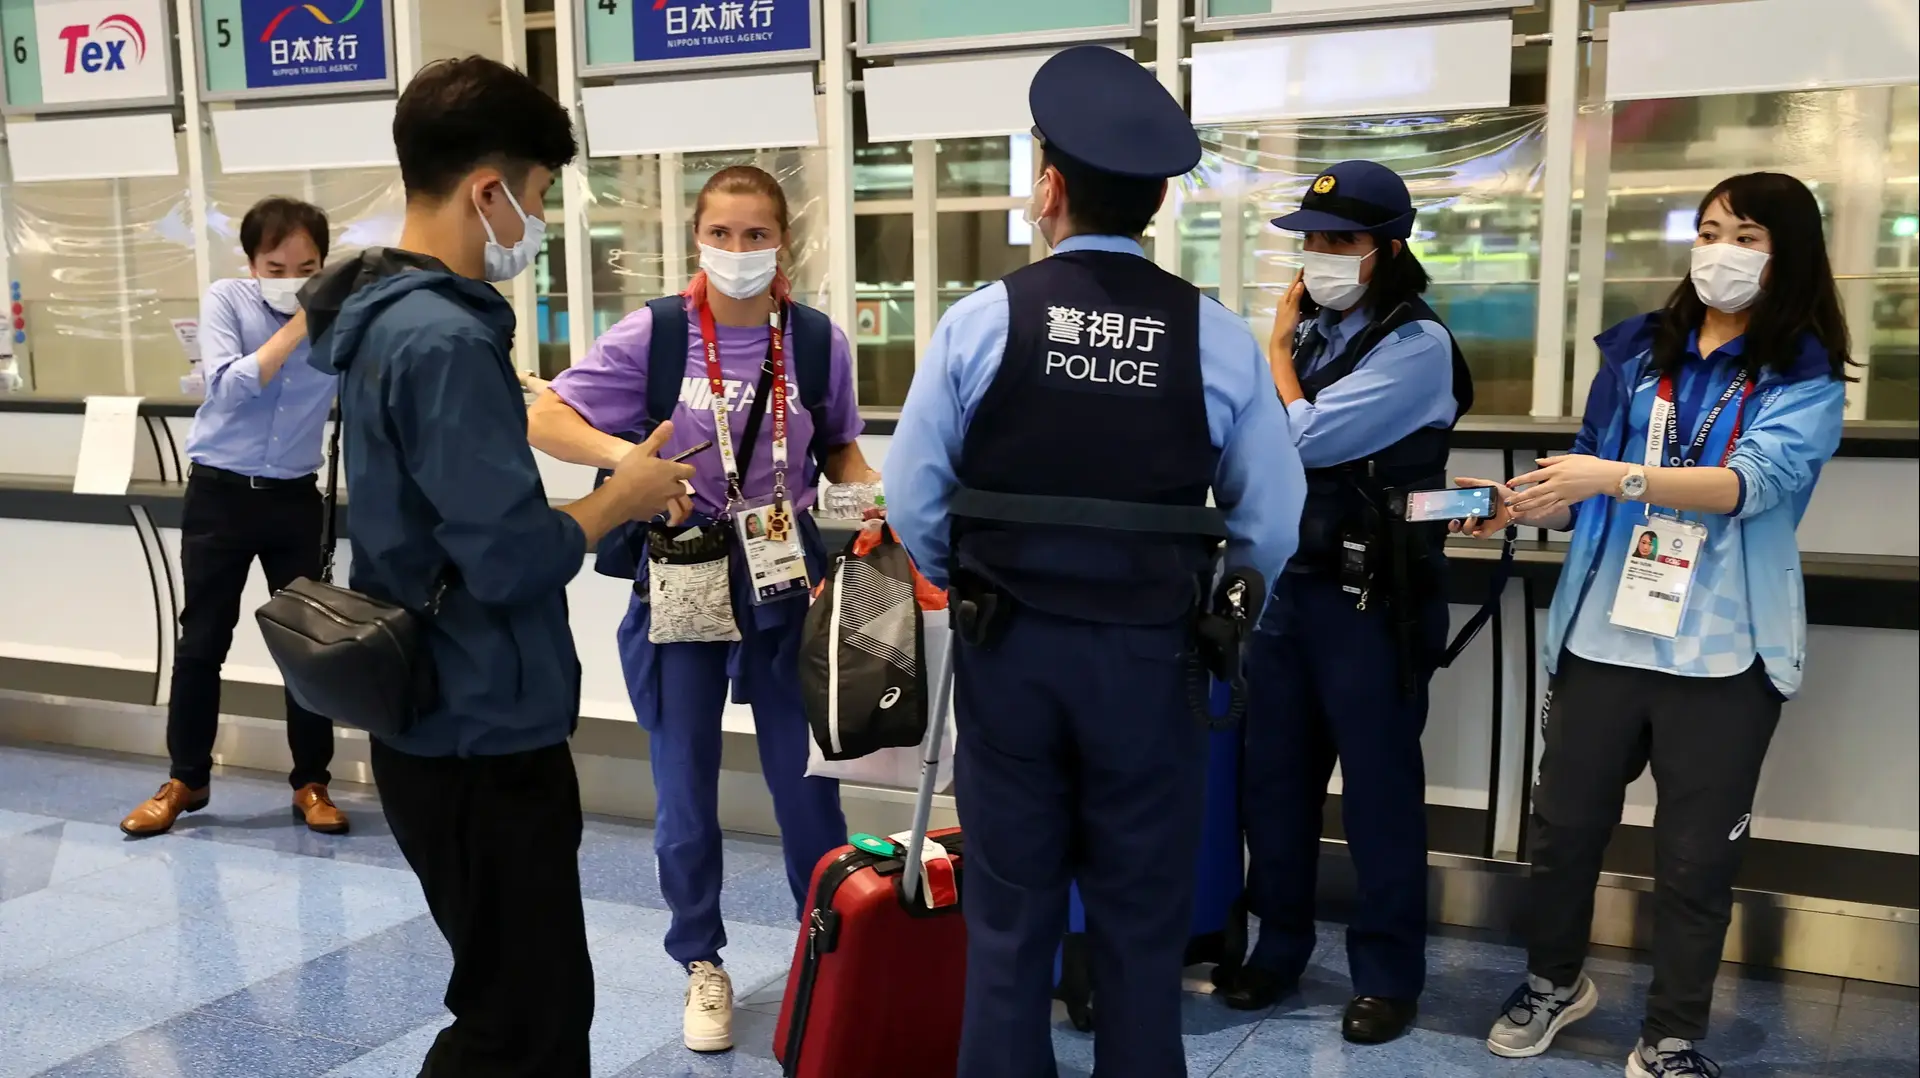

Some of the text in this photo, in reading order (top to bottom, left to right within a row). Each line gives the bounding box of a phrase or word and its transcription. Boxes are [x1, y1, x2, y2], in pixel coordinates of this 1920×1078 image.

[217, 19, 231, 48] 5
[666, 1, 775, 35] 日本旅行
[13, 36, 27, 64] 6
[58, 24, 126, 74] Tex
[270, 34, 359, 65] 日本旅行
[667, 32, 774, 48] NIPPON TRAVEL AGENCY
[272, 64, 358, 77] NIPPON TRAVEL AGENCY
[1046, 306, 1165, 352] 警視庁
[1045, 351, 1160, 388] POLICE
[1720, 380, 1740, 401] TOKYO
[1650, 403, 1667, 451] TOKYO 2020
[1667, 419, 1678, 444] TOKYO
[1693, 406, 1722, 447] TOKYO 2020
